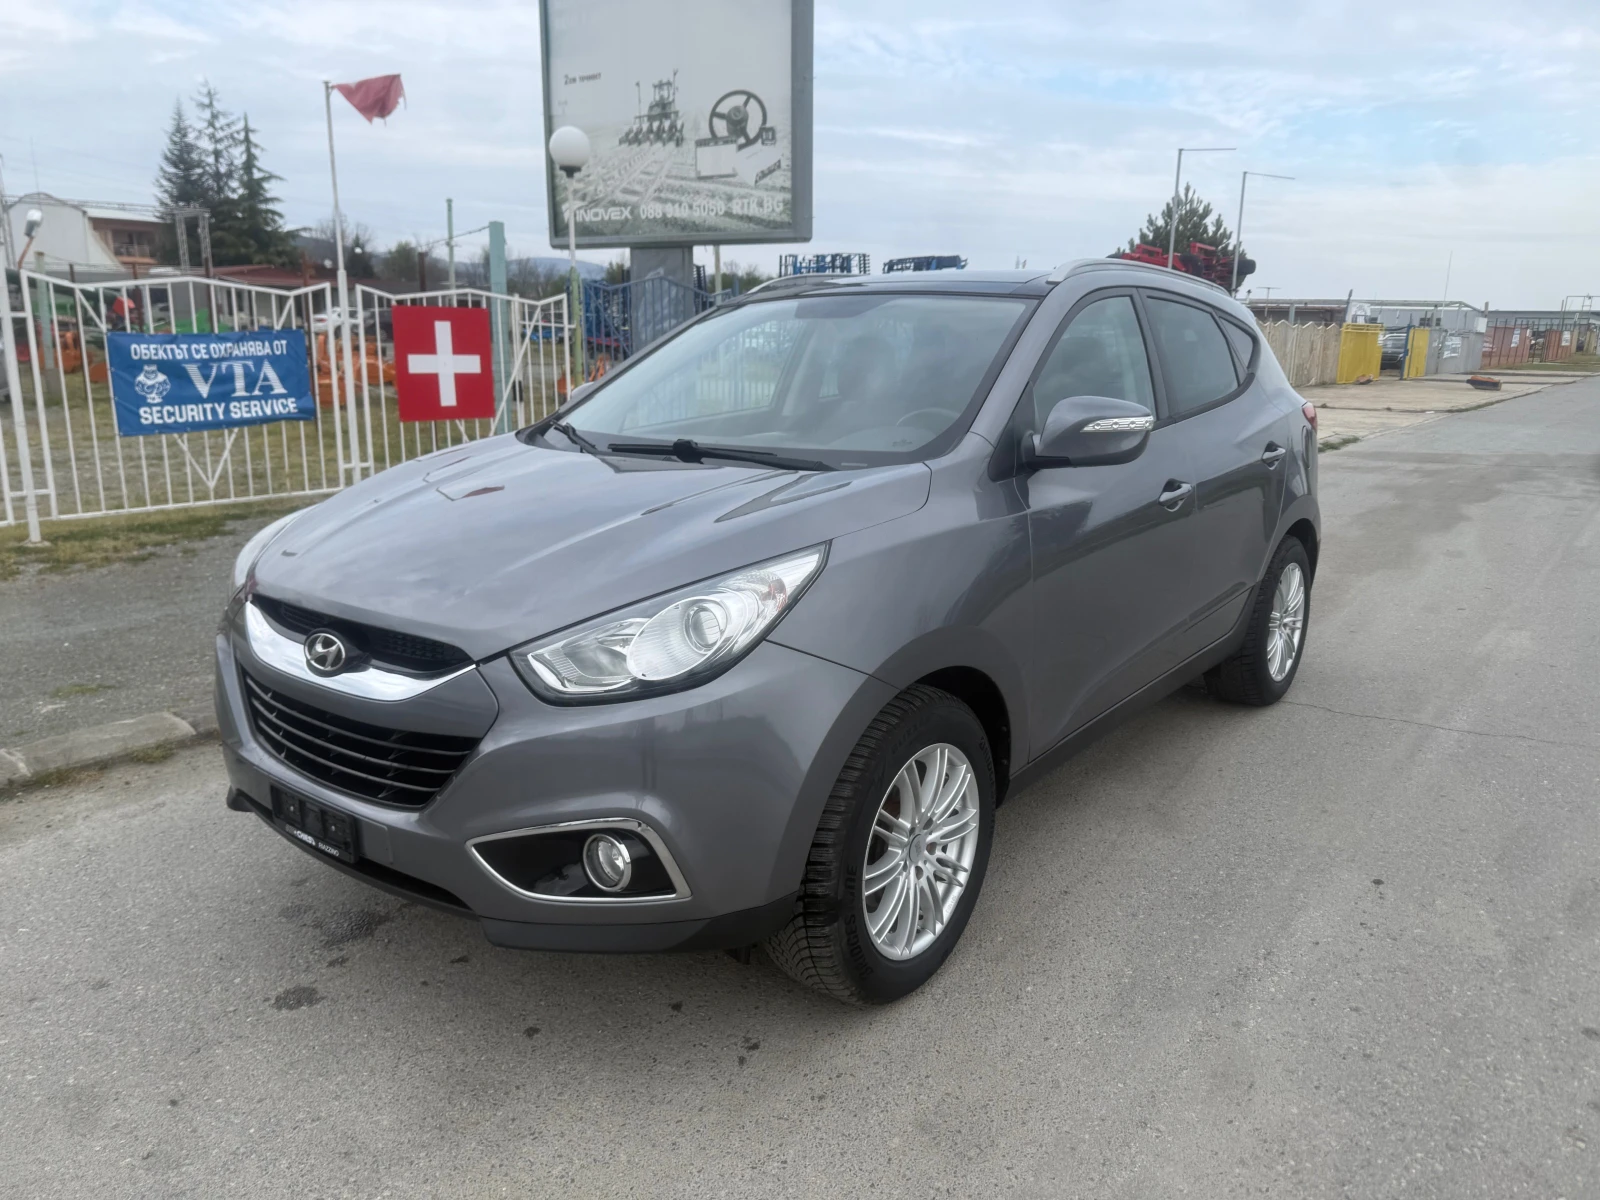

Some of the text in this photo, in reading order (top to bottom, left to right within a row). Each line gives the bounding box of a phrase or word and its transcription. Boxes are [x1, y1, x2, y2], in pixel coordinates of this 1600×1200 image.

[575, 206, 632, 222] INOVEX
[130, 339, 287, 360] ОБЕКТЪТ СЕ ОХРАНЯВА ОТ
[182, 359, 288, 399] VTA
[138, 398, 298, 425] SECURITY SERVICE
